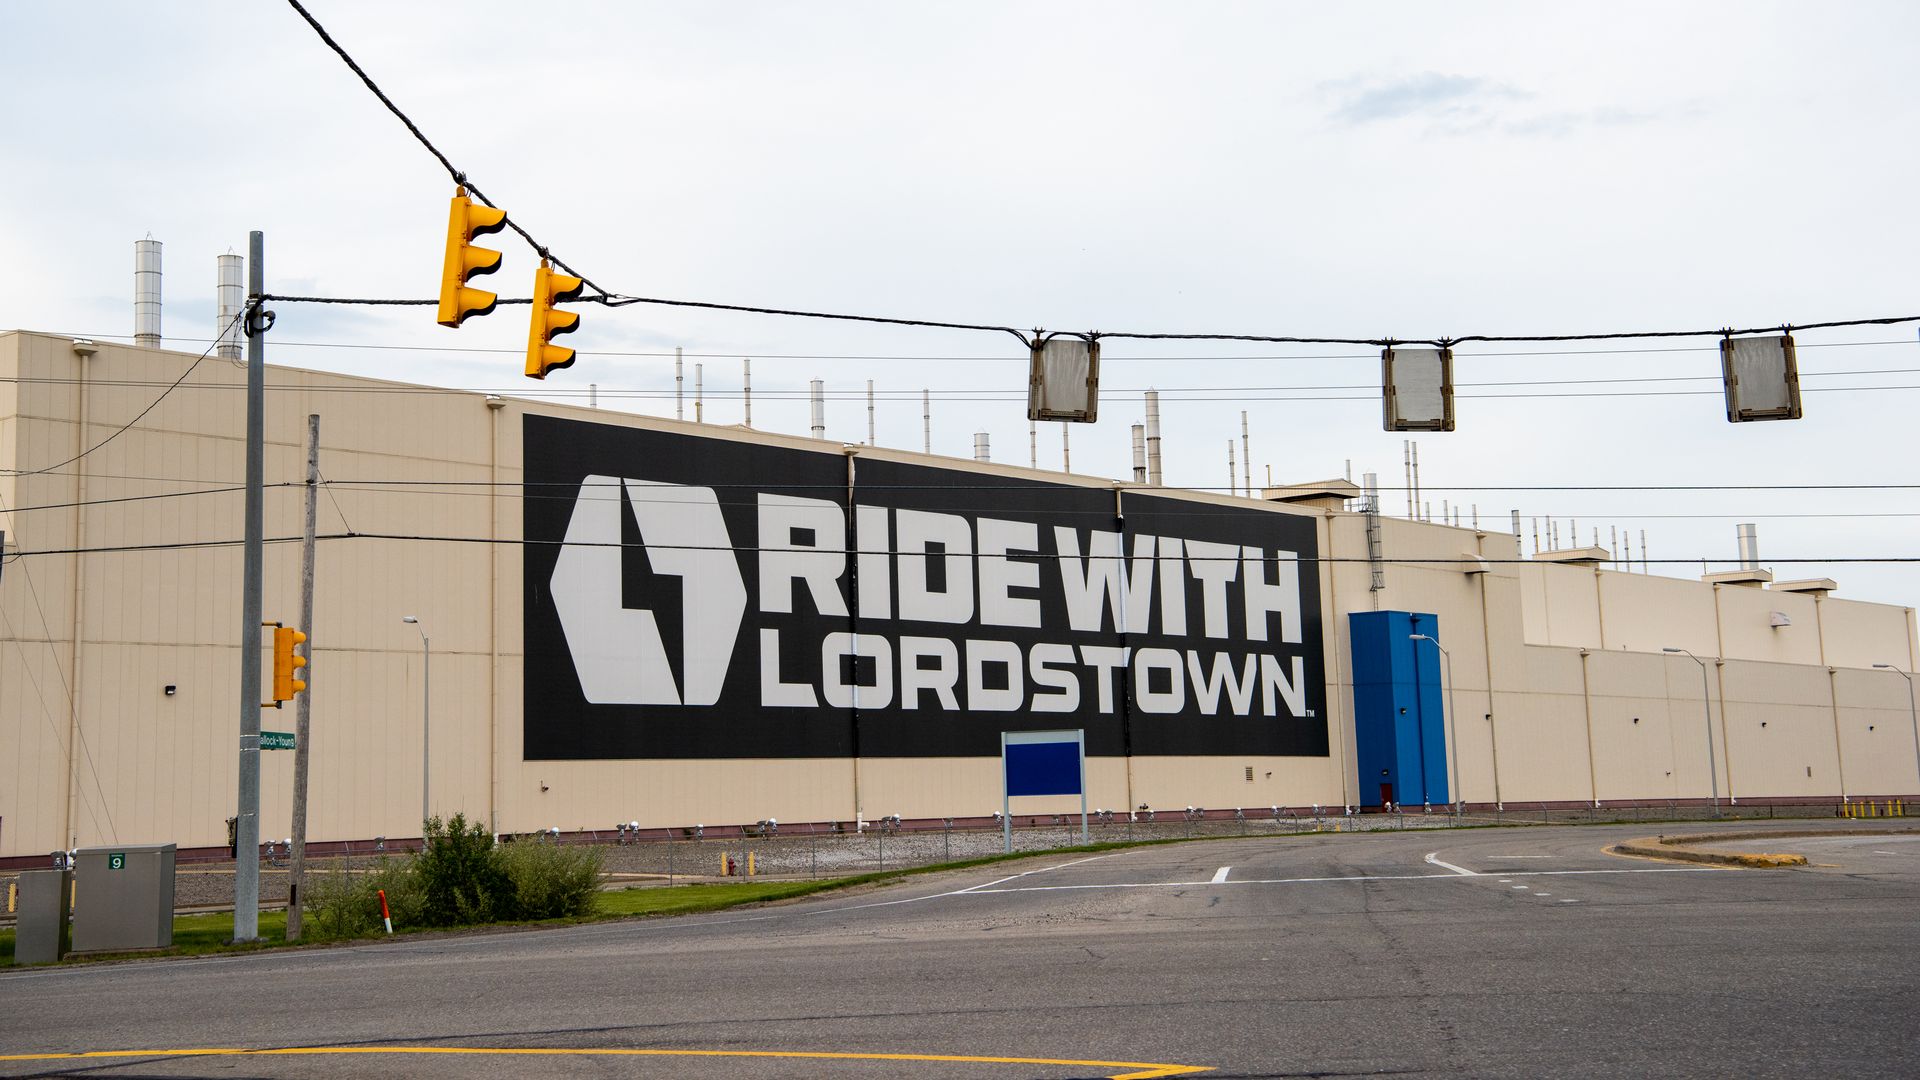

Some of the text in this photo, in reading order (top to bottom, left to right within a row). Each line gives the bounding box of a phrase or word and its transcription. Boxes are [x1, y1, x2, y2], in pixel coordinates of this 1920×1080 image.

[758, 492, 1302, 643] RIDE WITH
[760, 628, 1306, 717] LORDSTOWN
[112, 857, 122, 869] 9
